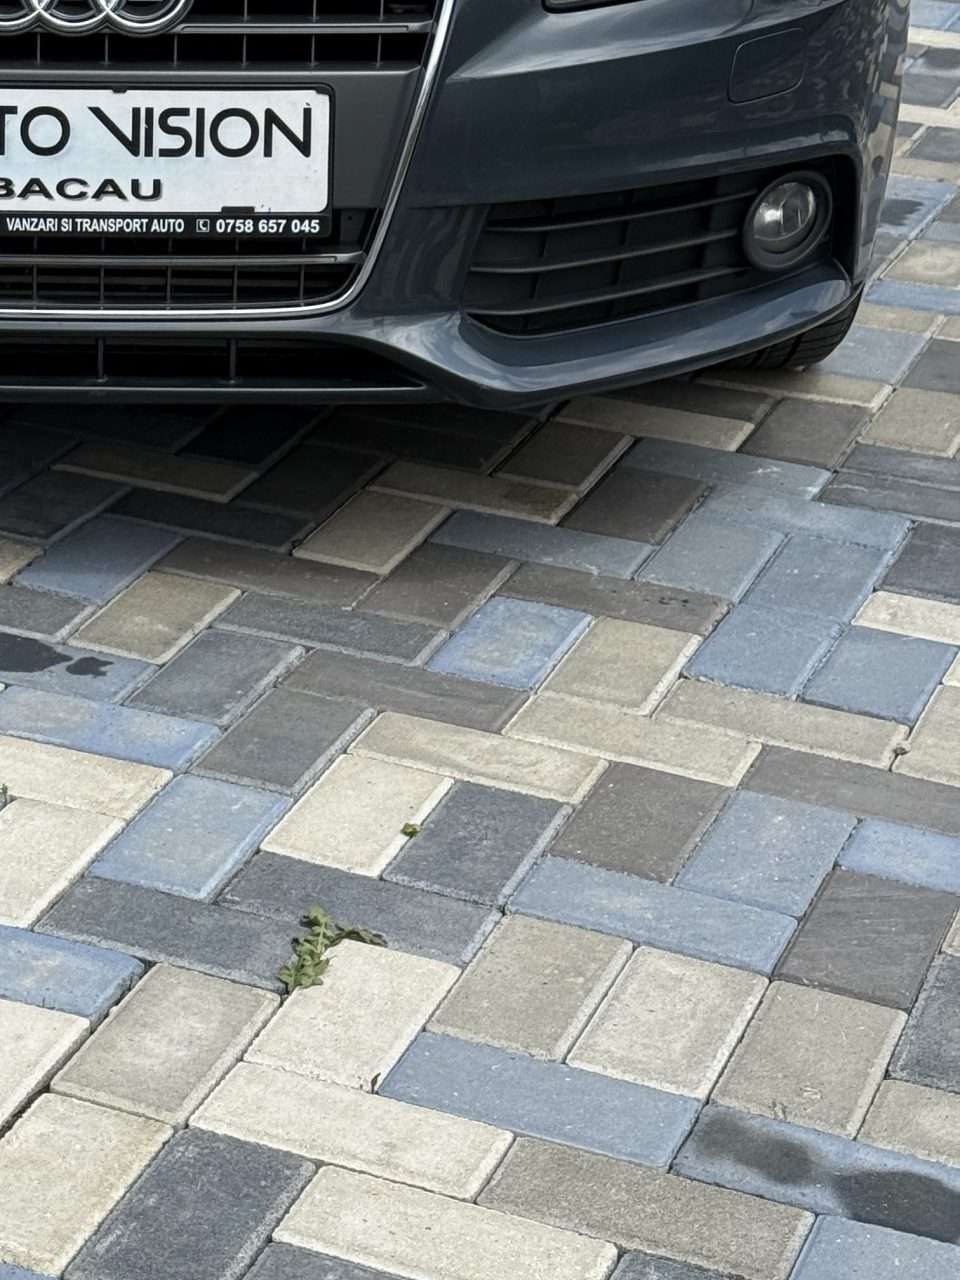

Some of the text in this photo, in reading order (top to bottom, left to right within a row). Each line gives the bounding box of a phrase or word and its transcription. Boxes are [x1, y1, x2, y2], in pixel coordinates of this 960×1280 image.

[88, 104, 312, 158] VISION
[6, 217, 58, 231] VANZARI
[61, 218, 73, 231] SI
[76, 218, 149, 232] TRANSPORT
[151, 218, 185, 232] AUTO
[216, 220, 253, 233] 0758
[258, 220, 286, 233] 657
[291, 220, 320, 233] 045
